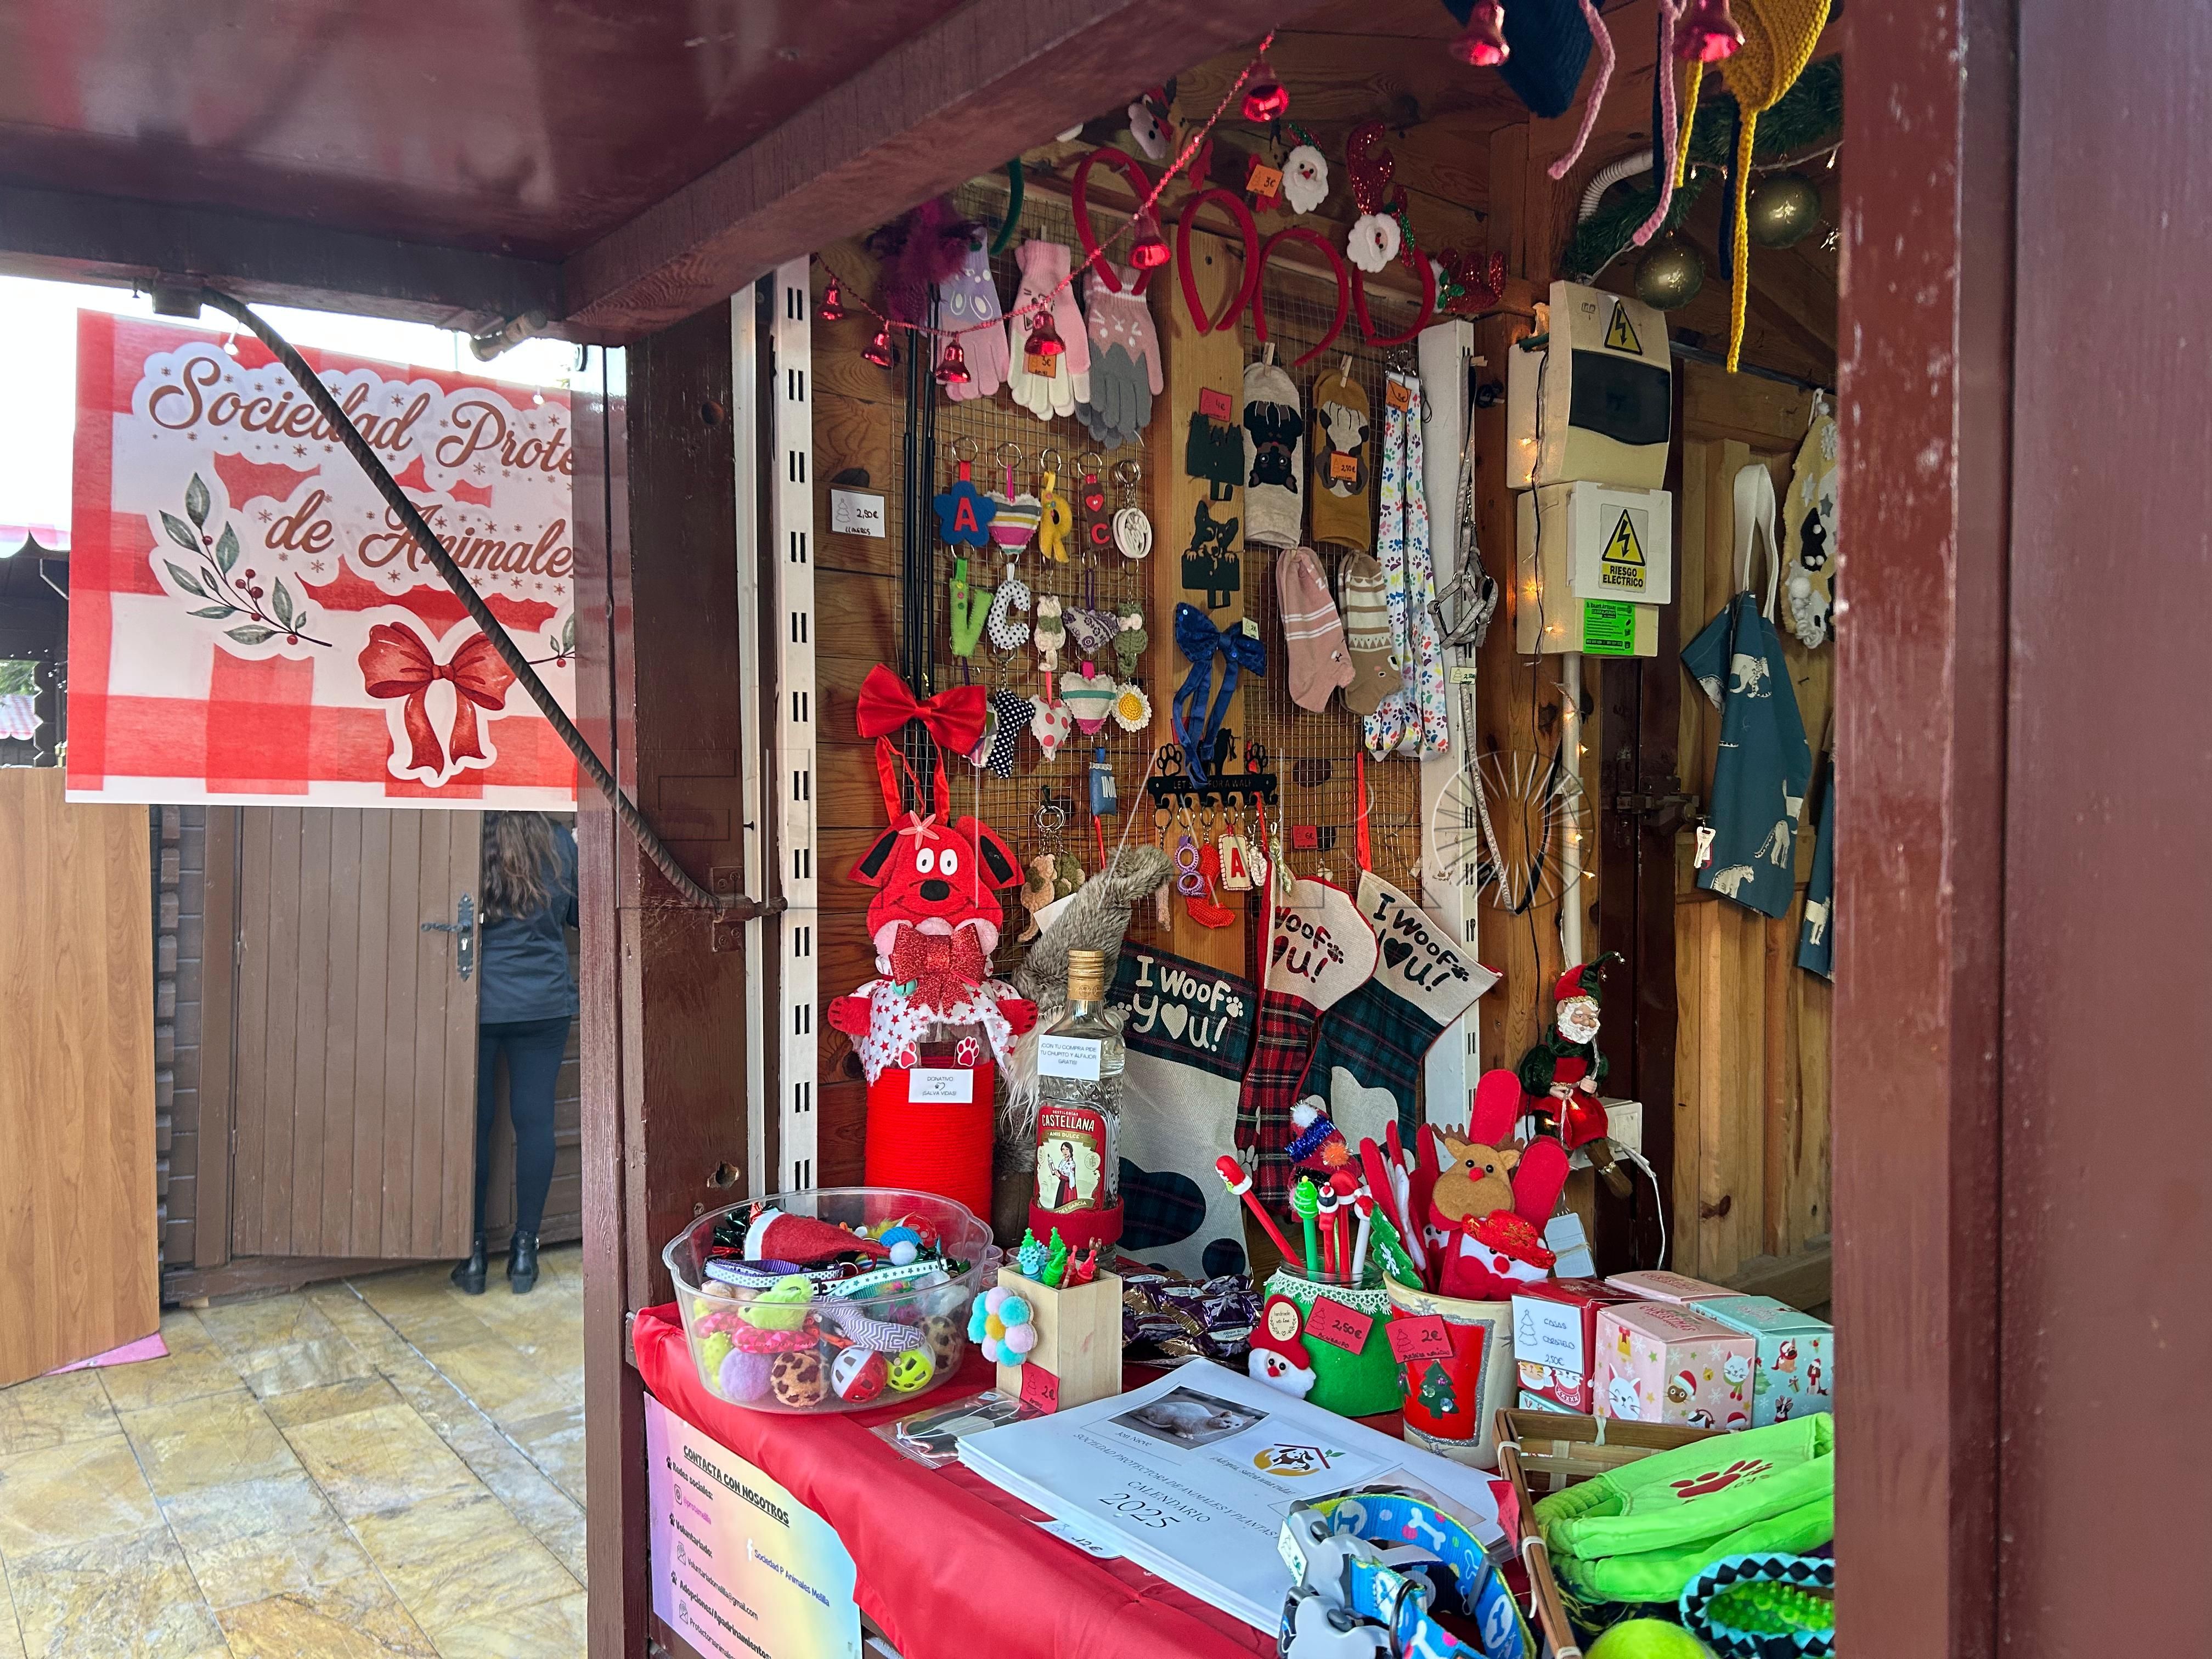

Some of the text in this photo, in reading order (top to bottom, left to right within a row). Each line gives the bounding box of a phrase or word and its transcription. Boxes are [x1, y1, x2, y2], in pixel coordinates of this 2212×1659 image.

[149, 357, 431, 452] Sociedad
[266, 490, 574, 578] de Animale
[1602, 574, 1644, 588] ELECTRICO
[1610, 565, 1638, 578] RIESGO
[1231, 847, 1245, 878] A
[1373, 892, 1396, 921] I
[1135, 955, 1155, 987] I
[1042, 1114, 1094, 1132] CASTELLANA
[1331, 1319, 1363, 1340] 2,50€
[1421, 1329, 1442, 1342] 2€
[1544, 1354, 1565, 1366] 2,50€
[1132, 1436, 1152, 1447] Nieve
[673, 1461, 689, 1481] Redes
[684, 1445, 789, 1525] CONTACTA CON NOSOTROS
[1073, 1434, 1116, 1455] SOCIEDAD
[1111, 1454, 1170, 1485] PROTECTORA
[1165, 1481, 1183, 1489] DE
[1180, 1487, 1228, 1511] ANIMALES
[1231, 1514, 1279, 1536] PLANTAS
[1098, 1492, 1181, 1528] 2025
[1128, 1481, 1210, 1523] CALENDARIO
[676, 1520, 713, 1559] Voluntariado:
[754, 1549, 780, 1573] Sociedad
[780, 1566, 785, 1575] P
[785, 1570, 811, 1594] Animales
